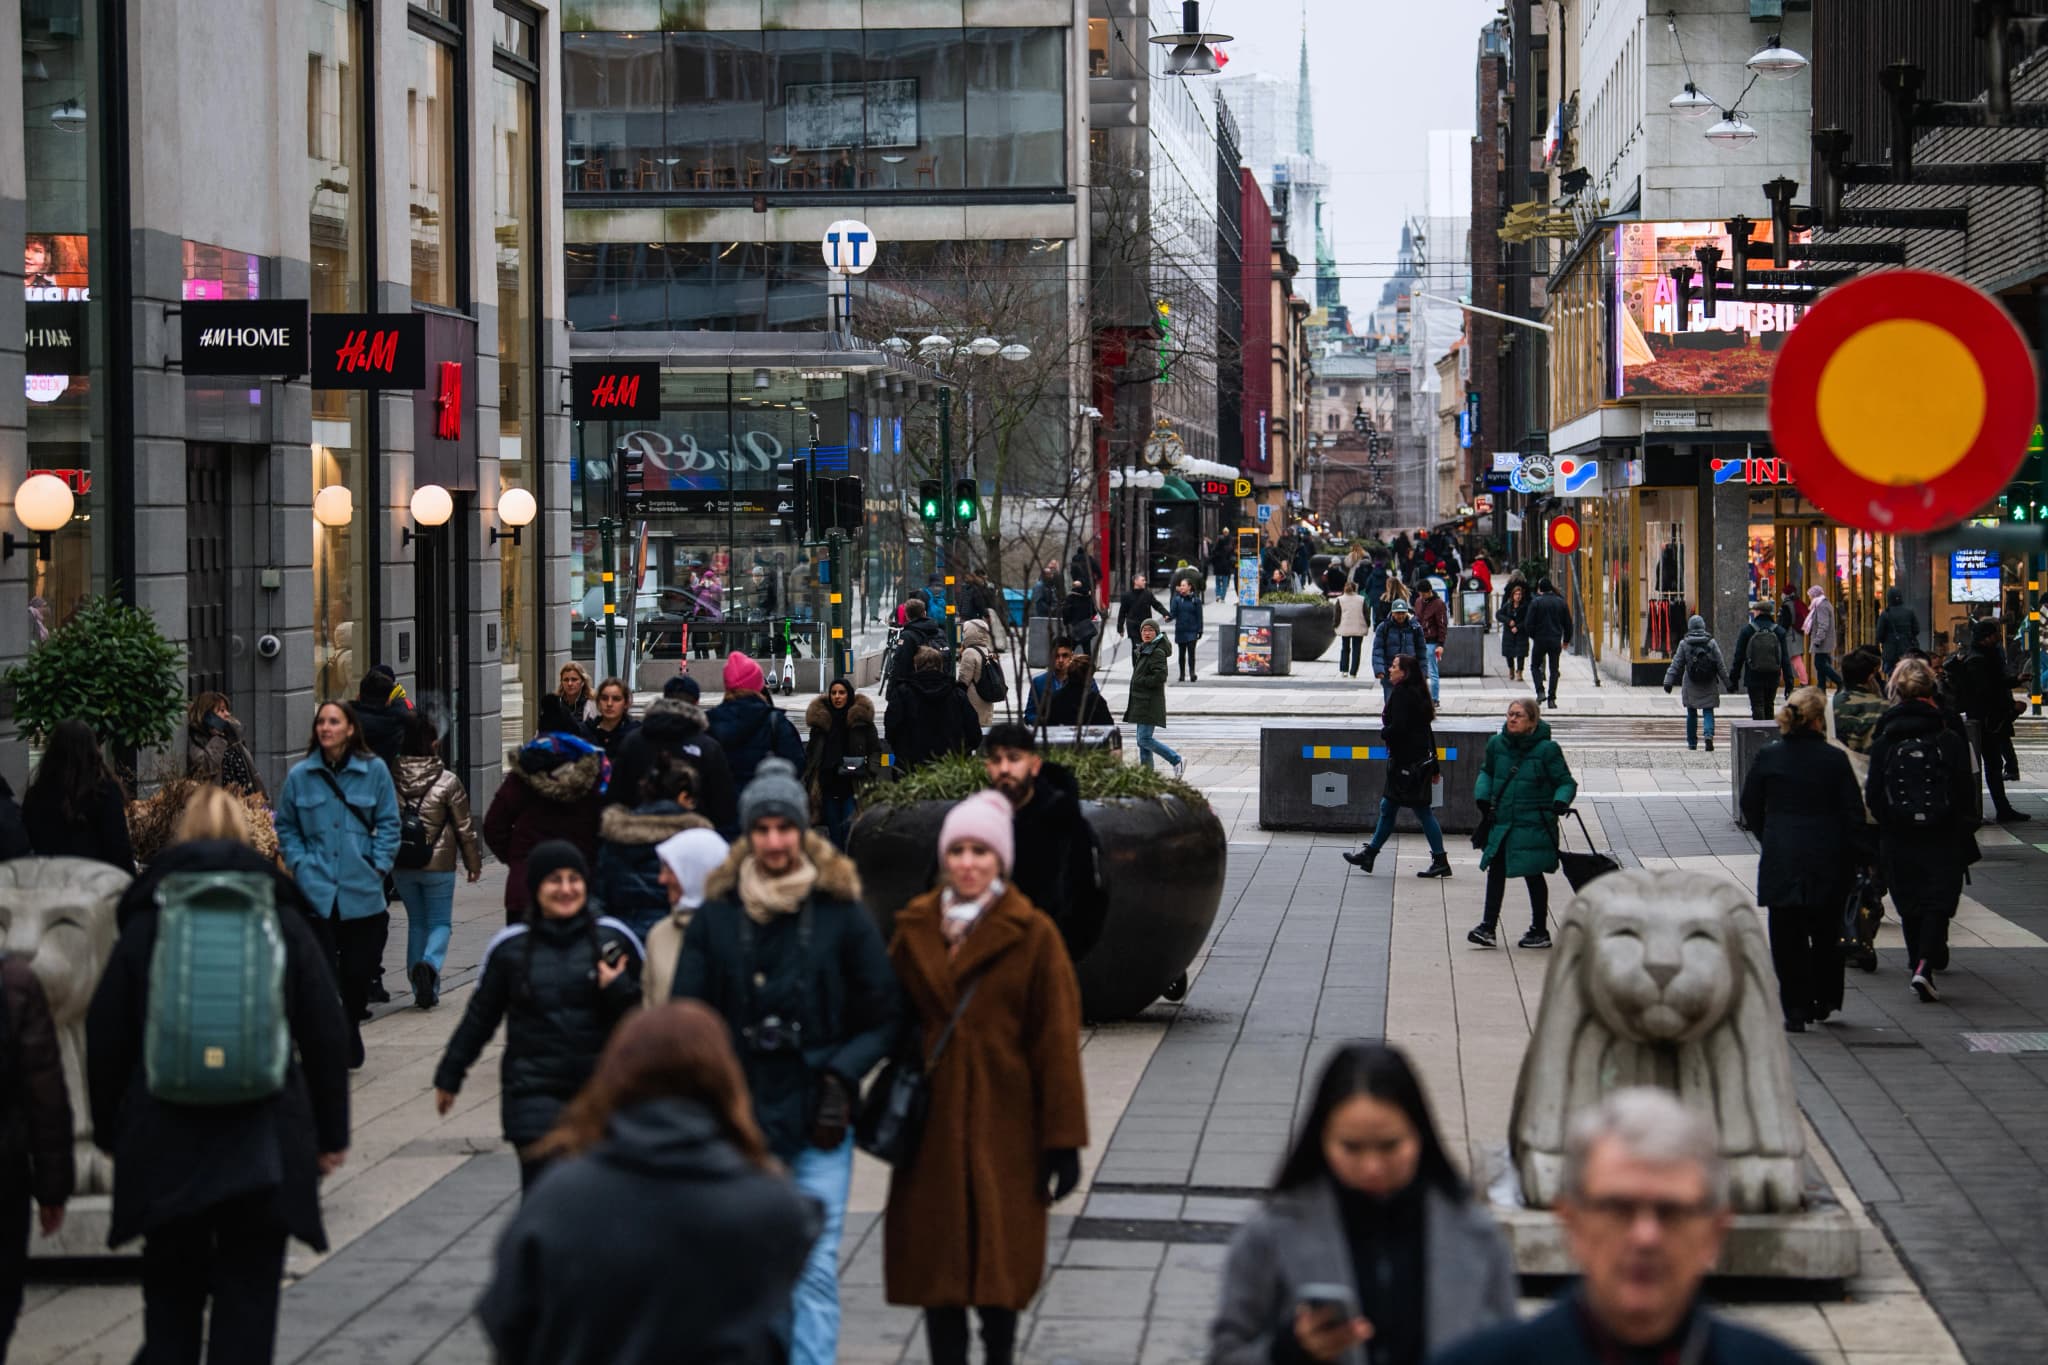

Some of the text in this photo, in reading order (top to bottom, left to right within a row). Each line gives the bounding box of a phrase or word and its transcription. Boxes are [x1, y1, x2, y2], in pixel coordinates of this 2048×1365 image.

[847, 232, 868, 267] T
[1717, 301, 1812, 332] UTBIL
[199, 328, 290, 347] H&M HOME
[336, 330, 399, 373] H&M
[591, 374, 640, 408] H&M
